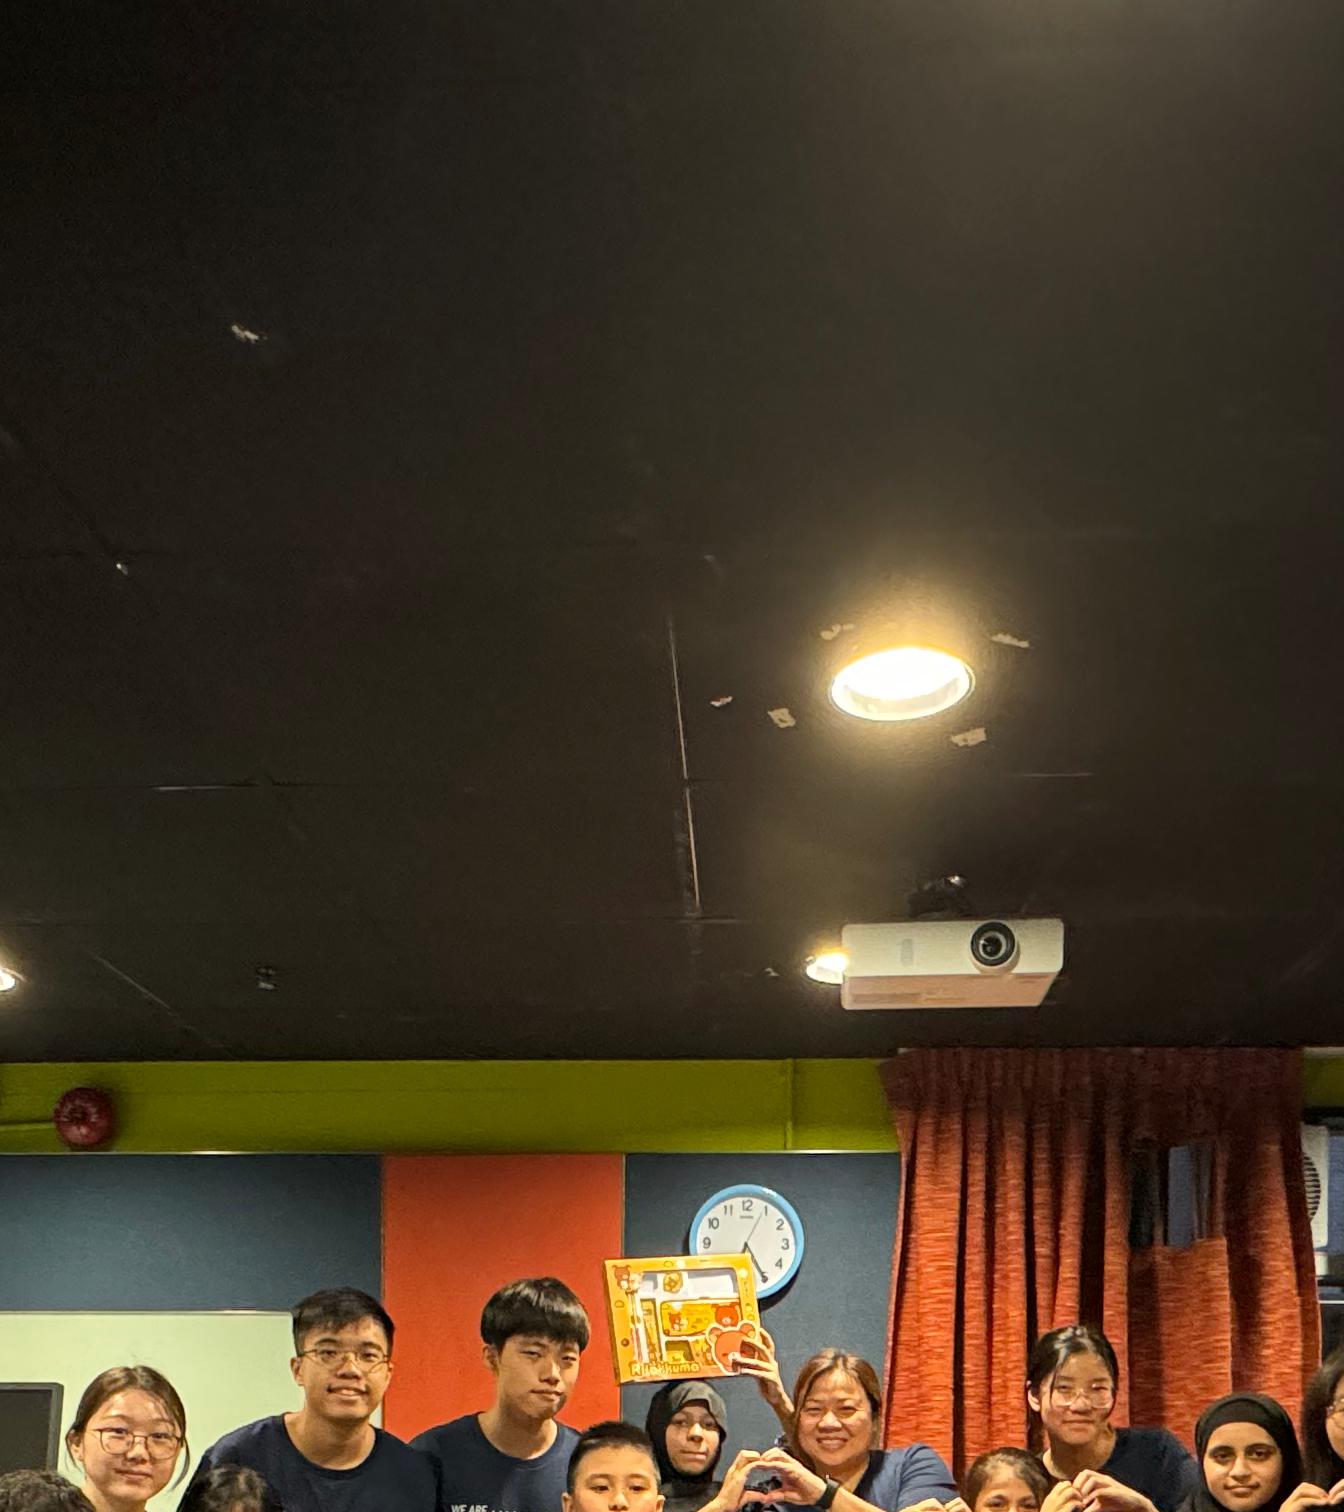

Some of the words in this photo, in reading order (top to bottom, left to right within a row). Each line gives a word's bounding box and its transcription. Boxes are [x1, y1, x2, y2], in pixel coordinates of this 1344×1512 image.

[723, 1204, 734, 1216] 11
[742, 1199, 753, 1212] 12
[708, 1217, 720, 1230] 10
[776, 1218, 785, 1231] 2
[703, 1236, 712, 1249] 9
[781, 1238, 790, 1250] 3
[775, 1257, 783, 1270] 4
